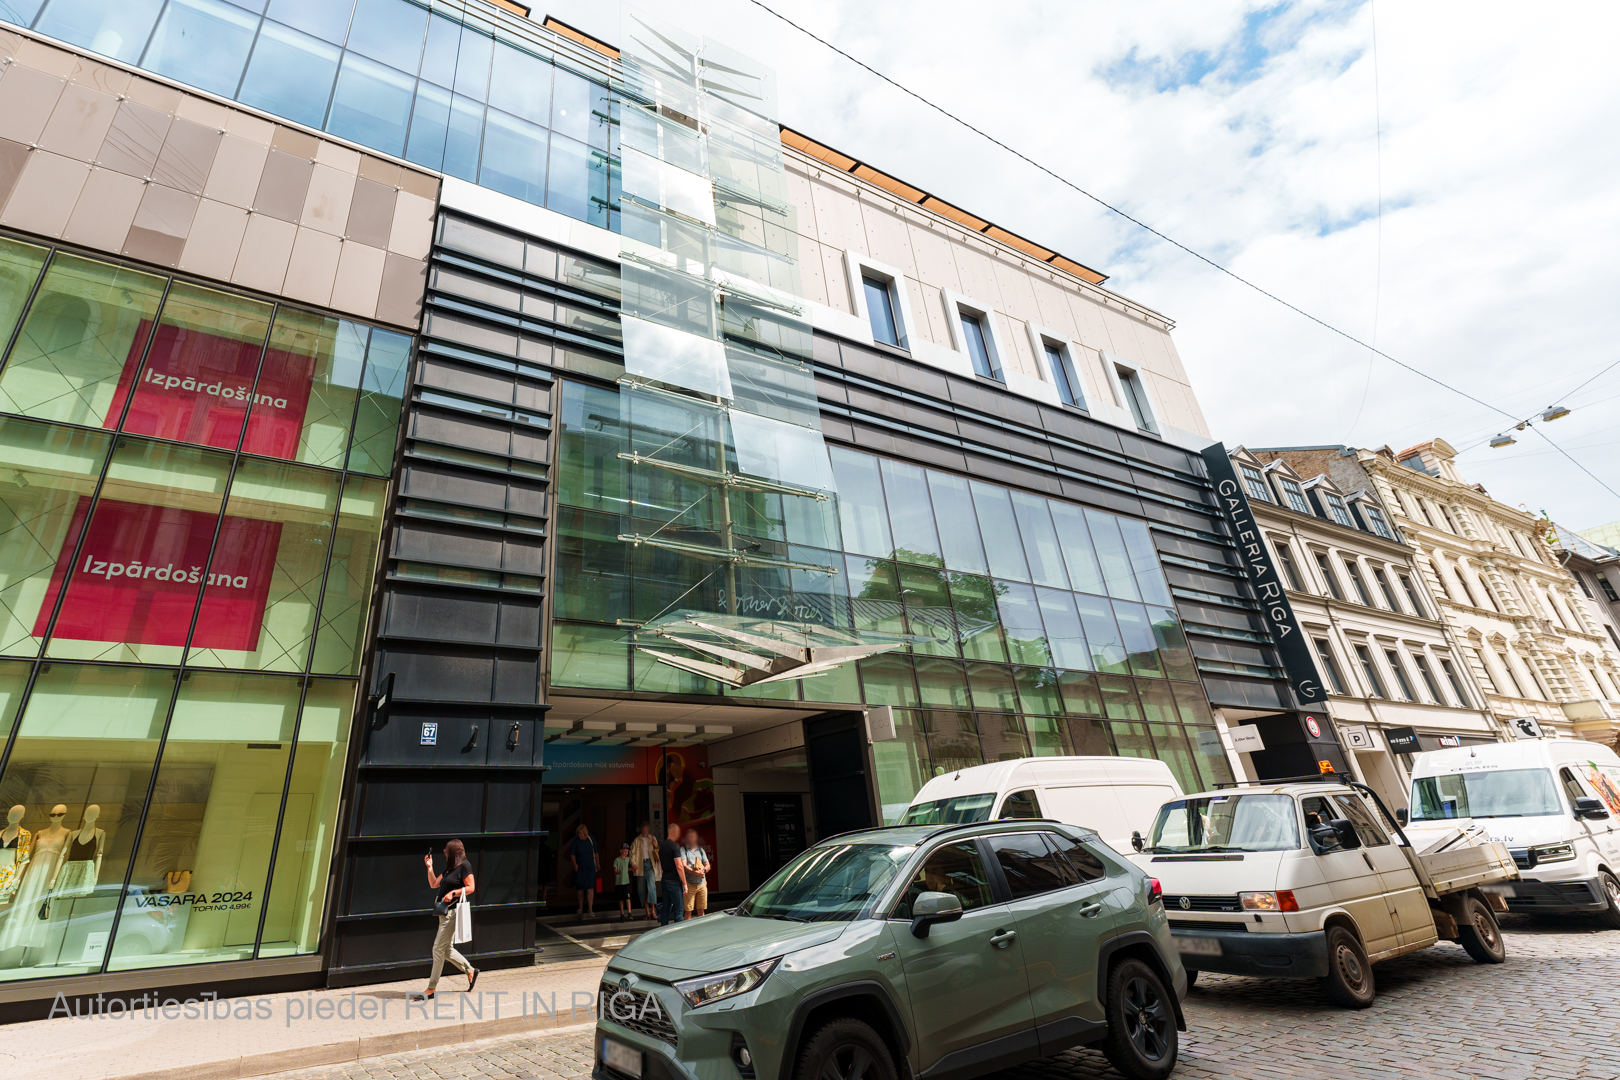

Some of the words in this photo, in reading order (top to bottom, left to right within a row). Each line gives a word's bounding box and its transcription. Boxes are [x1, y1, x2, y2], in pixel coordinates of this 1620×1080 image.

[145, 368, 288, 409] Izpārdošana
[1218, 479, 1268, 578] GALLERIA
[1258, 581, 1292, 638] RIGA
[83, 555, 249, 589] Izpārdošana
[872, 717, 890, 730] COS
[423, 727, 436, 737] 67
[1353, 735, 1361, 743] P
[553, 761, 593, 769] Izpārdošana
[135, 894, 208, 908] VASARA
[211, 891, 253, 904] 2024
